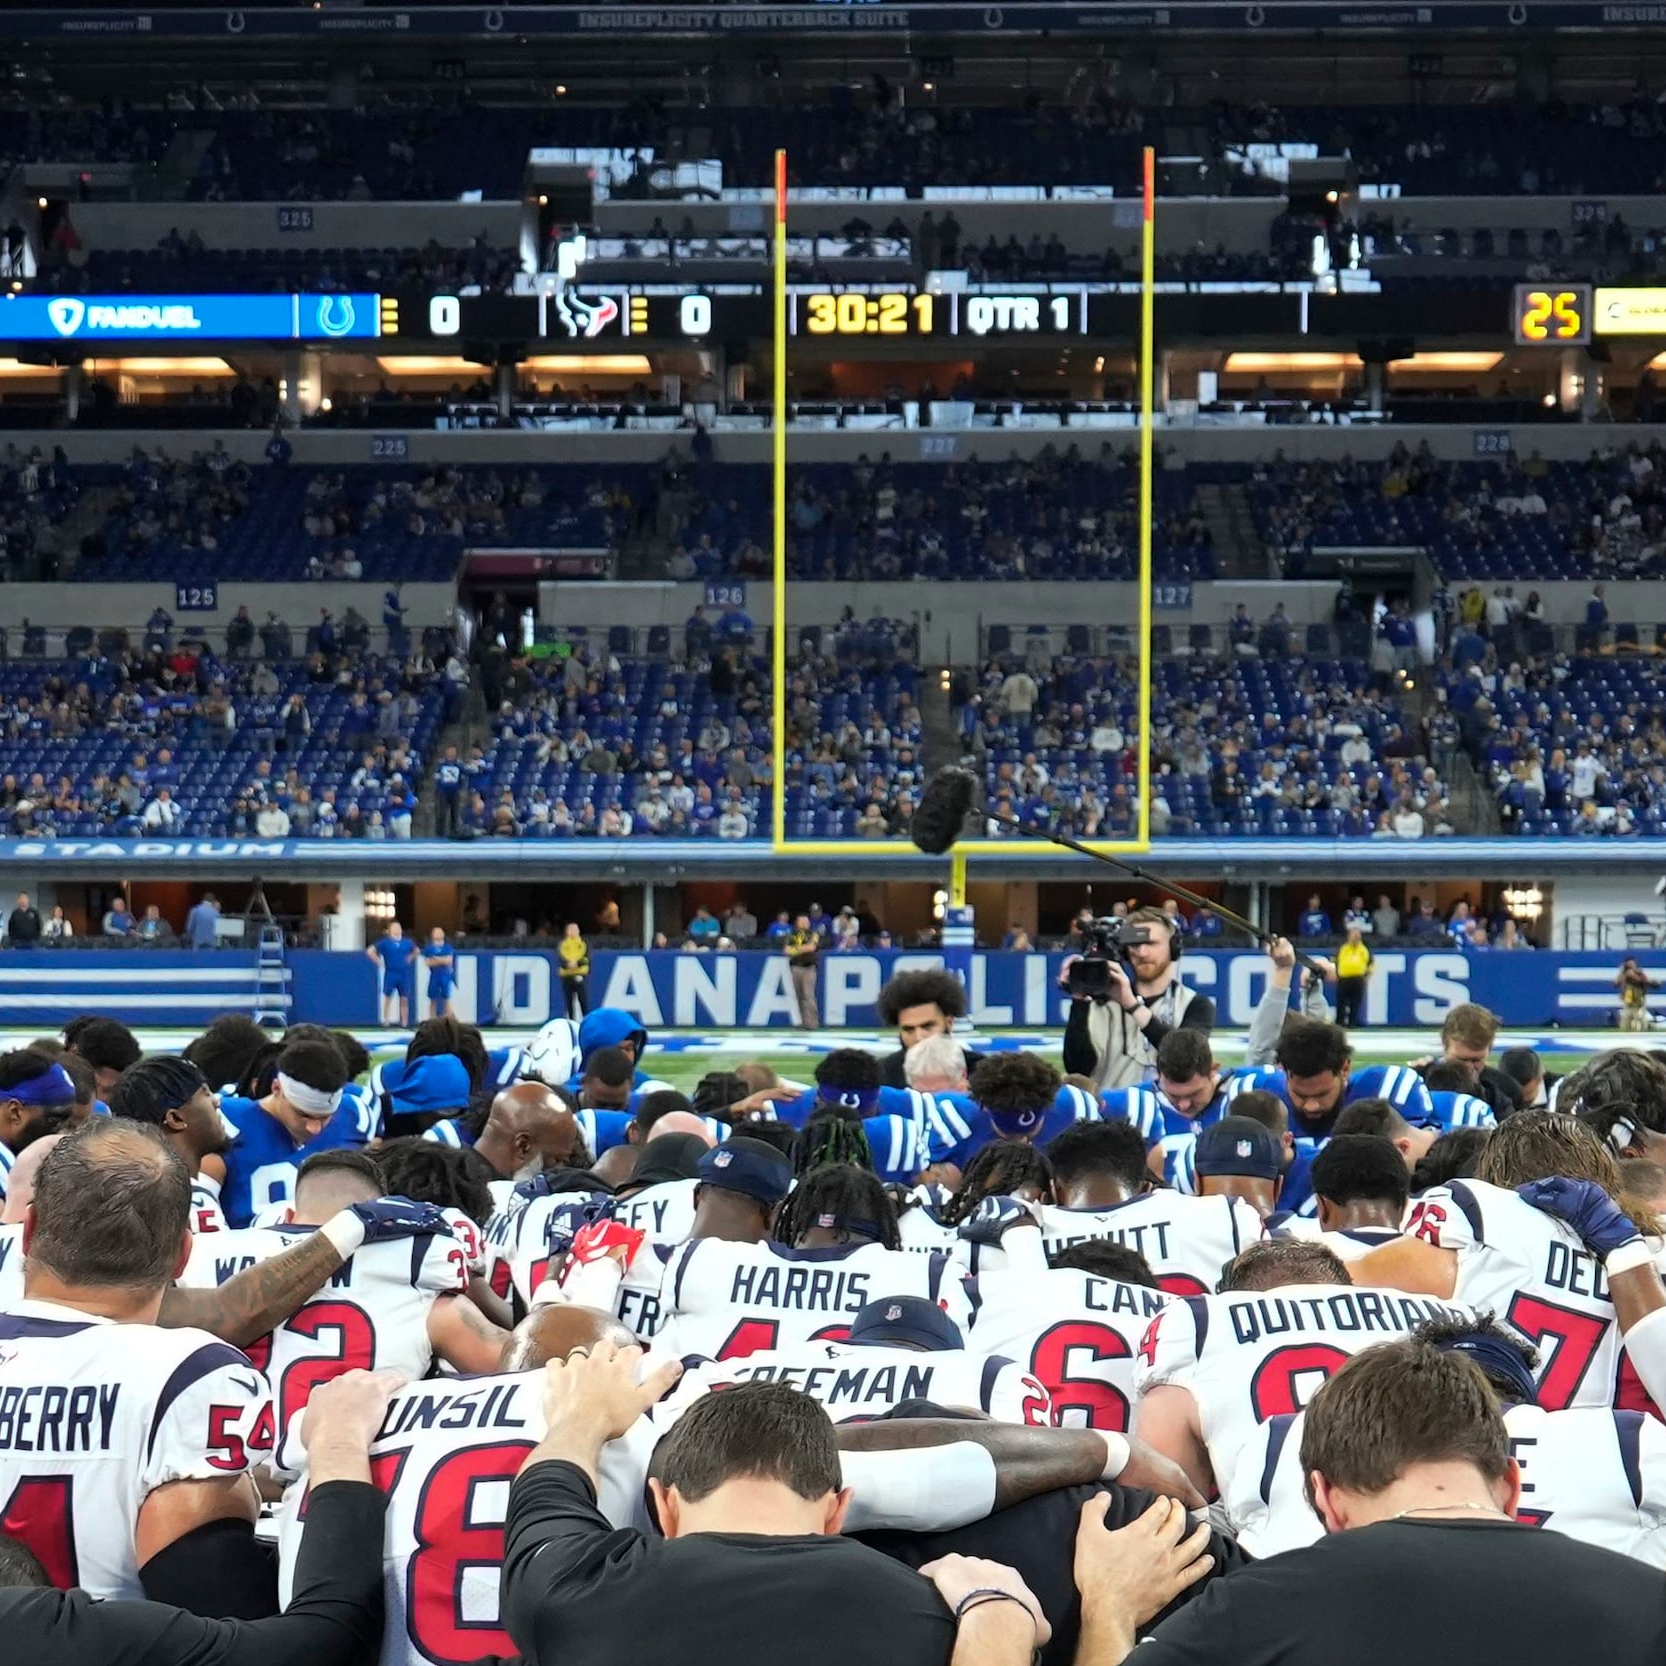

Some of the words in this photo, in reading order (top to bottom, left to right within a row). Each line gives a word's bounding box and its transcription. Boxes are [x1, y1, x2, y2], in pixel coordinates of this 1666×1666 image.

[720, 12, 851, 29] QUARTERBACK
[854, 11, 910, 27] SUITE
[86, 307, 201, 331] FANDUEL
[429, 296, 460, 335] 0
[680, 295, 711, 334] 0
[807, 294, 934, 335] 30:21
[967, 297, 1040, 334] QTR
[1051, 297, 1069, 332] 1
[1522, 292, 1581, 340] 25
[374, 440, 406, 456] 225
[178, 588, 214, 606] 125
[706, 587, 743, 604] 126
[1155, 586, 1190, 604] 127
[14, 842, 286, 857] STADIUM
[730, 1263, 871, 1314] HARRIS
[1083, 1276, 1166, 1319] CAN
[376, 1382, 529, 1442] UNSIL
[205, 1403, 277, 1472] 54
